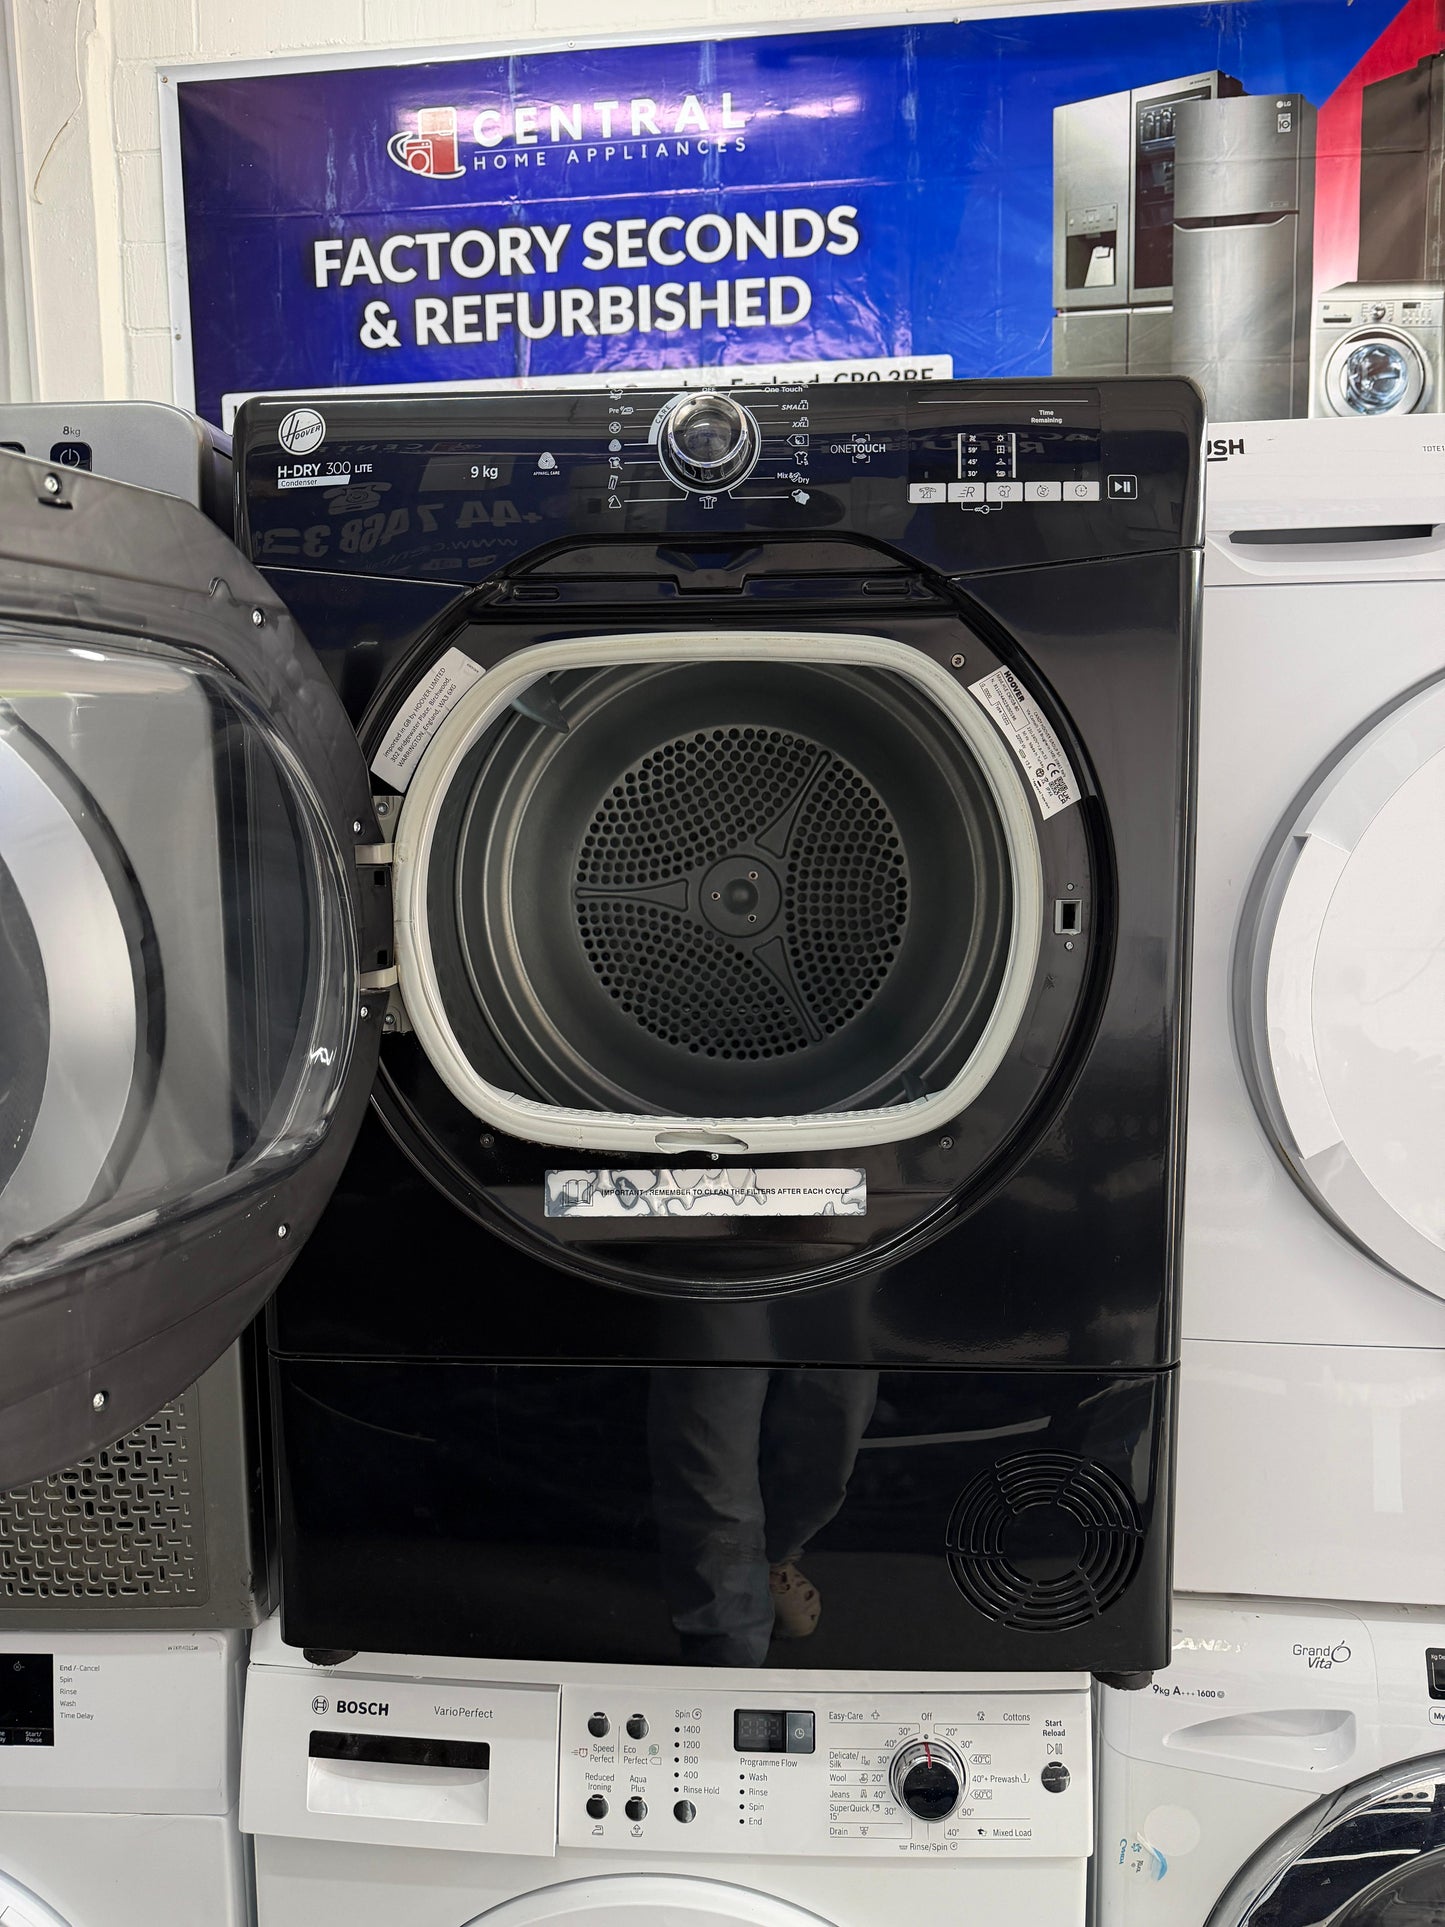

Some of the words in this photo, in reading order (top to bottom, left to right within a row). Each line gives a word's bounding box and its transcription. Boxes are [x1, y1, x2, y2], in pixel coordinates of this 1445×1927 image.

[473, 92, 746, 148] CENTRAL
[474, 152, 546, 171] HOME
[567, 136, 746, 165] APPLIANCES
[313, 224, 571, 288] FACTORY
[582, 205, 860, 271] SECONDS
[359, 300, 402, 349] &
[415, 275, 812, 346] REFURBISHED
[655, 405, 671, 424] CARE
[62, 425, 81, 437] 8kg
[830, 443, 886, 455] ONETOUCH
[277, 463, 321, 478] H-DRY
[326, 461, 351, 475] 300
[354, 463, 373, 474] LITE
[470, 465, 479, 478] 9
[482, 465, 499, 480] kg
[280, 477, 318, 488] Condenser
[798, 477, 810, 485] Dry
[1004, 670, 1025, 703] HOOVER
[403, 718, 411, 728] GB
[409, 712, 417, 720] by
[414, 689, 432, 713] HOOVER
[429, 667, 446, 690] LIMITED
[438, 695, 450, 708] WA3
[446, 683, 457, 696] 6XG
[391, 751, 400, 763] 302
[398, 720, 421, 752] Bridgewater
[650, 1189, 691, 1197] REMEMBER
[693, 1188, 703, 1196] TO
[704, 1188, 729, 1196] CLEAN
[730, 1188, 745, 1196] THE
[746, 1188, 776, 1196] FILTERS
[777, 1188, 802, 1196] AFTER
[803, 1187, 824, 1196] EACH
[825, 1187, 851, 1196] CYCLE
[1308, 1656, 1333, 1669] Vita
[60, 1676, 73, 1684] Spin
[1197, 1689, 1216, 1698] 1600
[336, 1700, 389, 1717] BOSCH
[434, 1705, 494, 1719] VarioPerfect
[76, 1712, 94, 1721] Delay
[675, 1709, 691, 1720] Spin
[828, 1711, 864, 1721] Easy-Care
[921, 1712, 933, 1722] Off
[1002, 1713, 1031, 1722] Cottons
[1045, 1719, 1063, 1727] Start
[683, 1725, 701, 1734] 1400
[898, 1727, 911, 1737] 30°
[945, 1727, 958, 1737] 20°
[1042, 1729, 1066, 1737] Reload
[592, 1743, 615, 1754] Speed
[683, 1741, 701, 1749] 1200
[884, 1739, 897, 1748] 40°
[960, 1740, 973, 1749] 30°
[623, 1745, 637, 1754] Eco
[589, 1753, 615, 1764] Perfect
[623, 1755, 648, 1765] Perfect
[683, 1756, 699, 1764] 800
[829, 1750, 860, 1761] Delicate/
[877, 1755, 890, 1764] 30°
[739, 1758, 780, 1769] Programme
[781, 1759, 798, 1768] Flow
[829, 1759, 842, 1769] Silk
[585, 1772, 615, 1782] Reduced
[629, 1774, 647, 1785] Aqua
[683, 1771, 699, 1779] 400
[749, 1773, 768, 1782] Wash
[829, 1773, 847, 1782] Wool
[871, 1773, 884, 1783] 20°
[990, 1774, 1020, 1783] Prewash
[588, 1783, 612, 1793] Ironing
[630, 1784, 646, 1793] Plus
[683, 1786, 702, 1794] Rinse
[703, 1786, 720, 1795] Hold
[748, 1788, 769, 1796] Rinse
[829, 1789, 850, 1799] Jeans
[873, 1789, 886, 1799] 40°
[748, 1802, 765, 1812] Spin
[829, 1803, 870, 1814] SuperQuick
[884, 1807, 897, 1816] 30°
[961, 1807, 975, 1817] 90°
[748, 1817, 763, 1826] End
[829, 1827, 848, 1836] Drain
[947, 1828, 960, 1837] 40°
[992, 1828, 1013, 1837] Mixed
[1014, 1828, 1032, 1838] Load
[909, 1842, 948, 1853] Rinse/Spin
